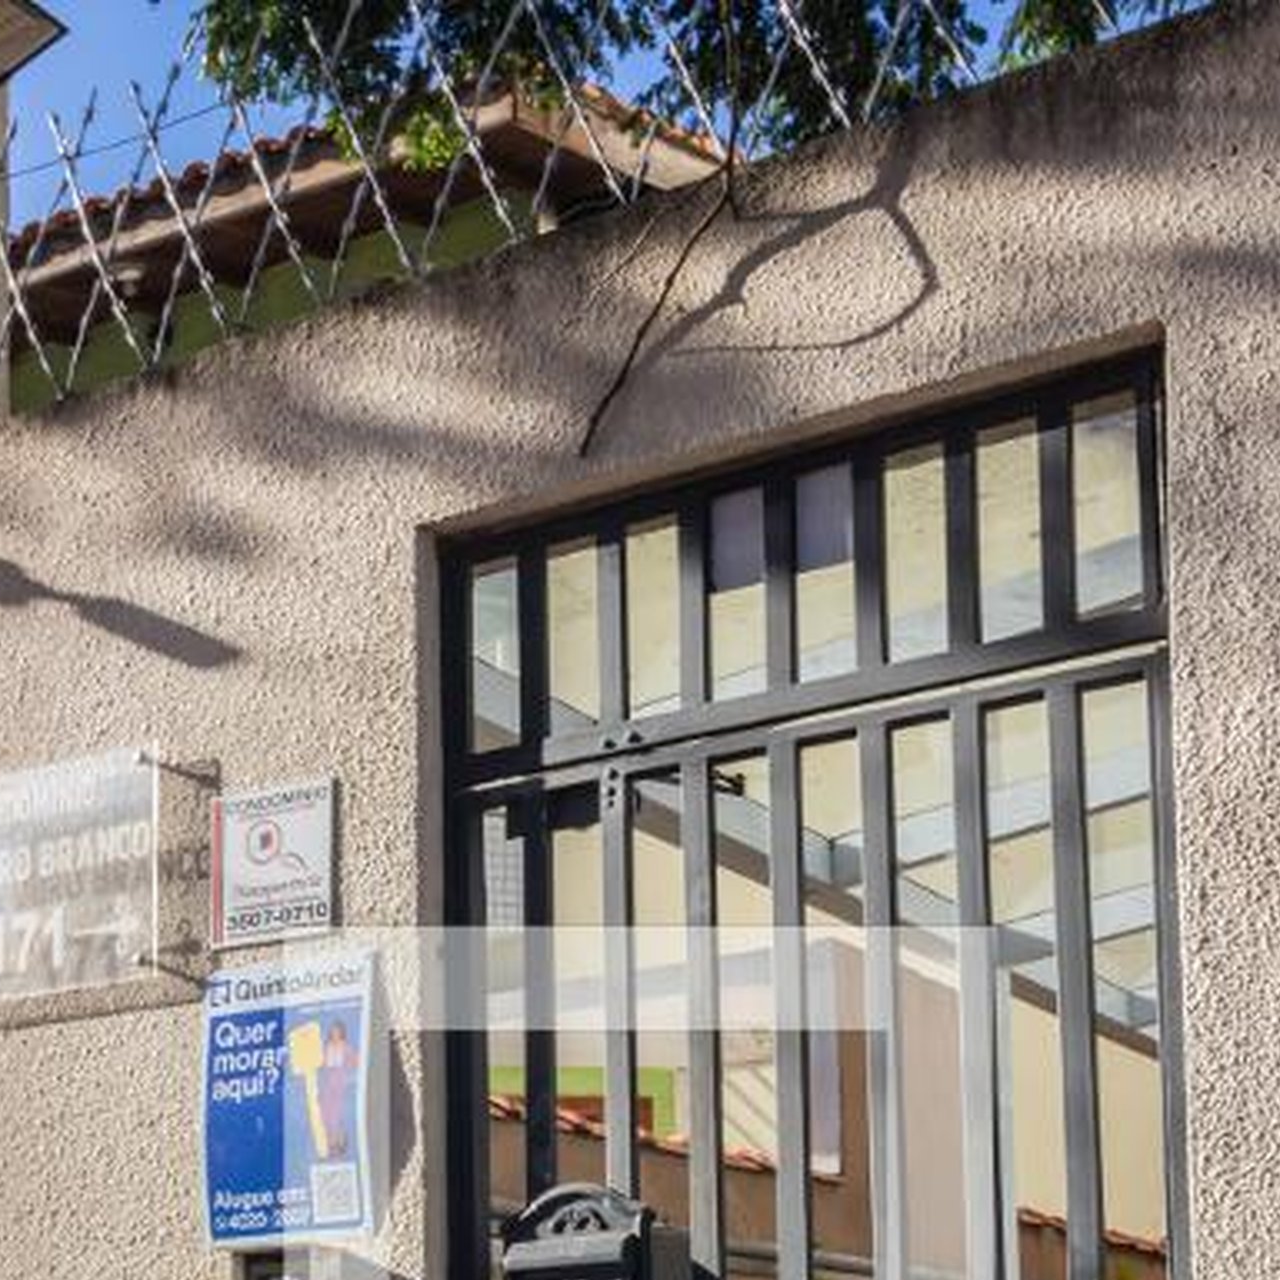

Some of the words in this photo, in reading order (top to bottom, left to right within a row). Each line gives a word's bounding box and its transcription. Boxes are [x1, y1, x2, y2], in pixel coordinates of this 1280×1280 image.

[215, 1019, 278, 1049] Quer
[213, 1046, 287, 1074] morar
[212, 1070, 280, 1103] aqui?
